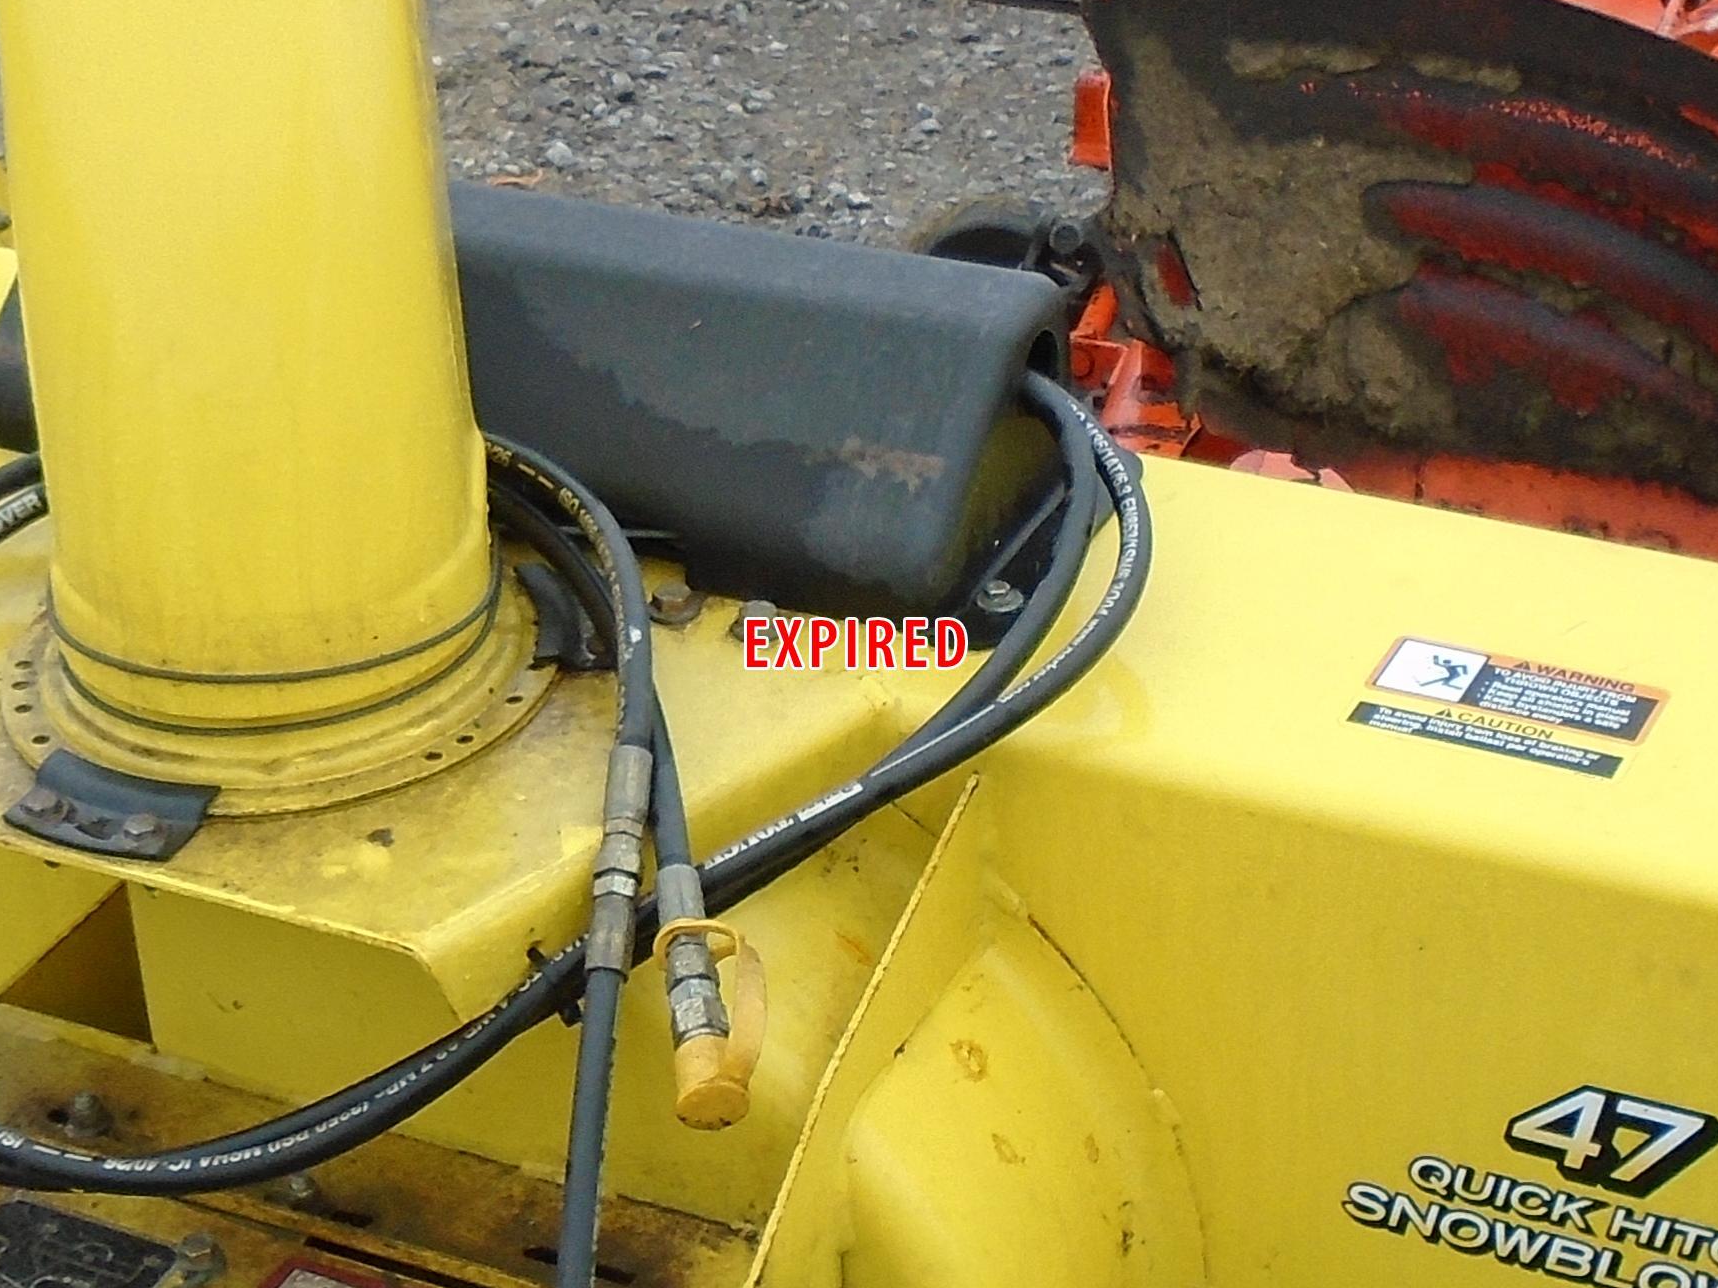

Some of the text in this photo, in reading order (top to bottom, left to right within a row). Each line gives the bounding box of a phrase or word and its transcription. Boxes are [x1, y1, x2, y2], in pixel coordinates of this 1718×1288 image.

[1494, 667, 1512, 676] TO
[1513, 671, 1551, 684] AVOID
[1599, 689, 1637, 703] FROM
[1537, 664, 1636, 692] WARNING
[1379, 706, 1393, 715] To
[1393, 710, 1428, 722] avoid
[1538, 741, 1585, 758] braking
[1458, 712, 1554, 739] CAUTION
[1409, 1156, 1601, 1232] QUICK
